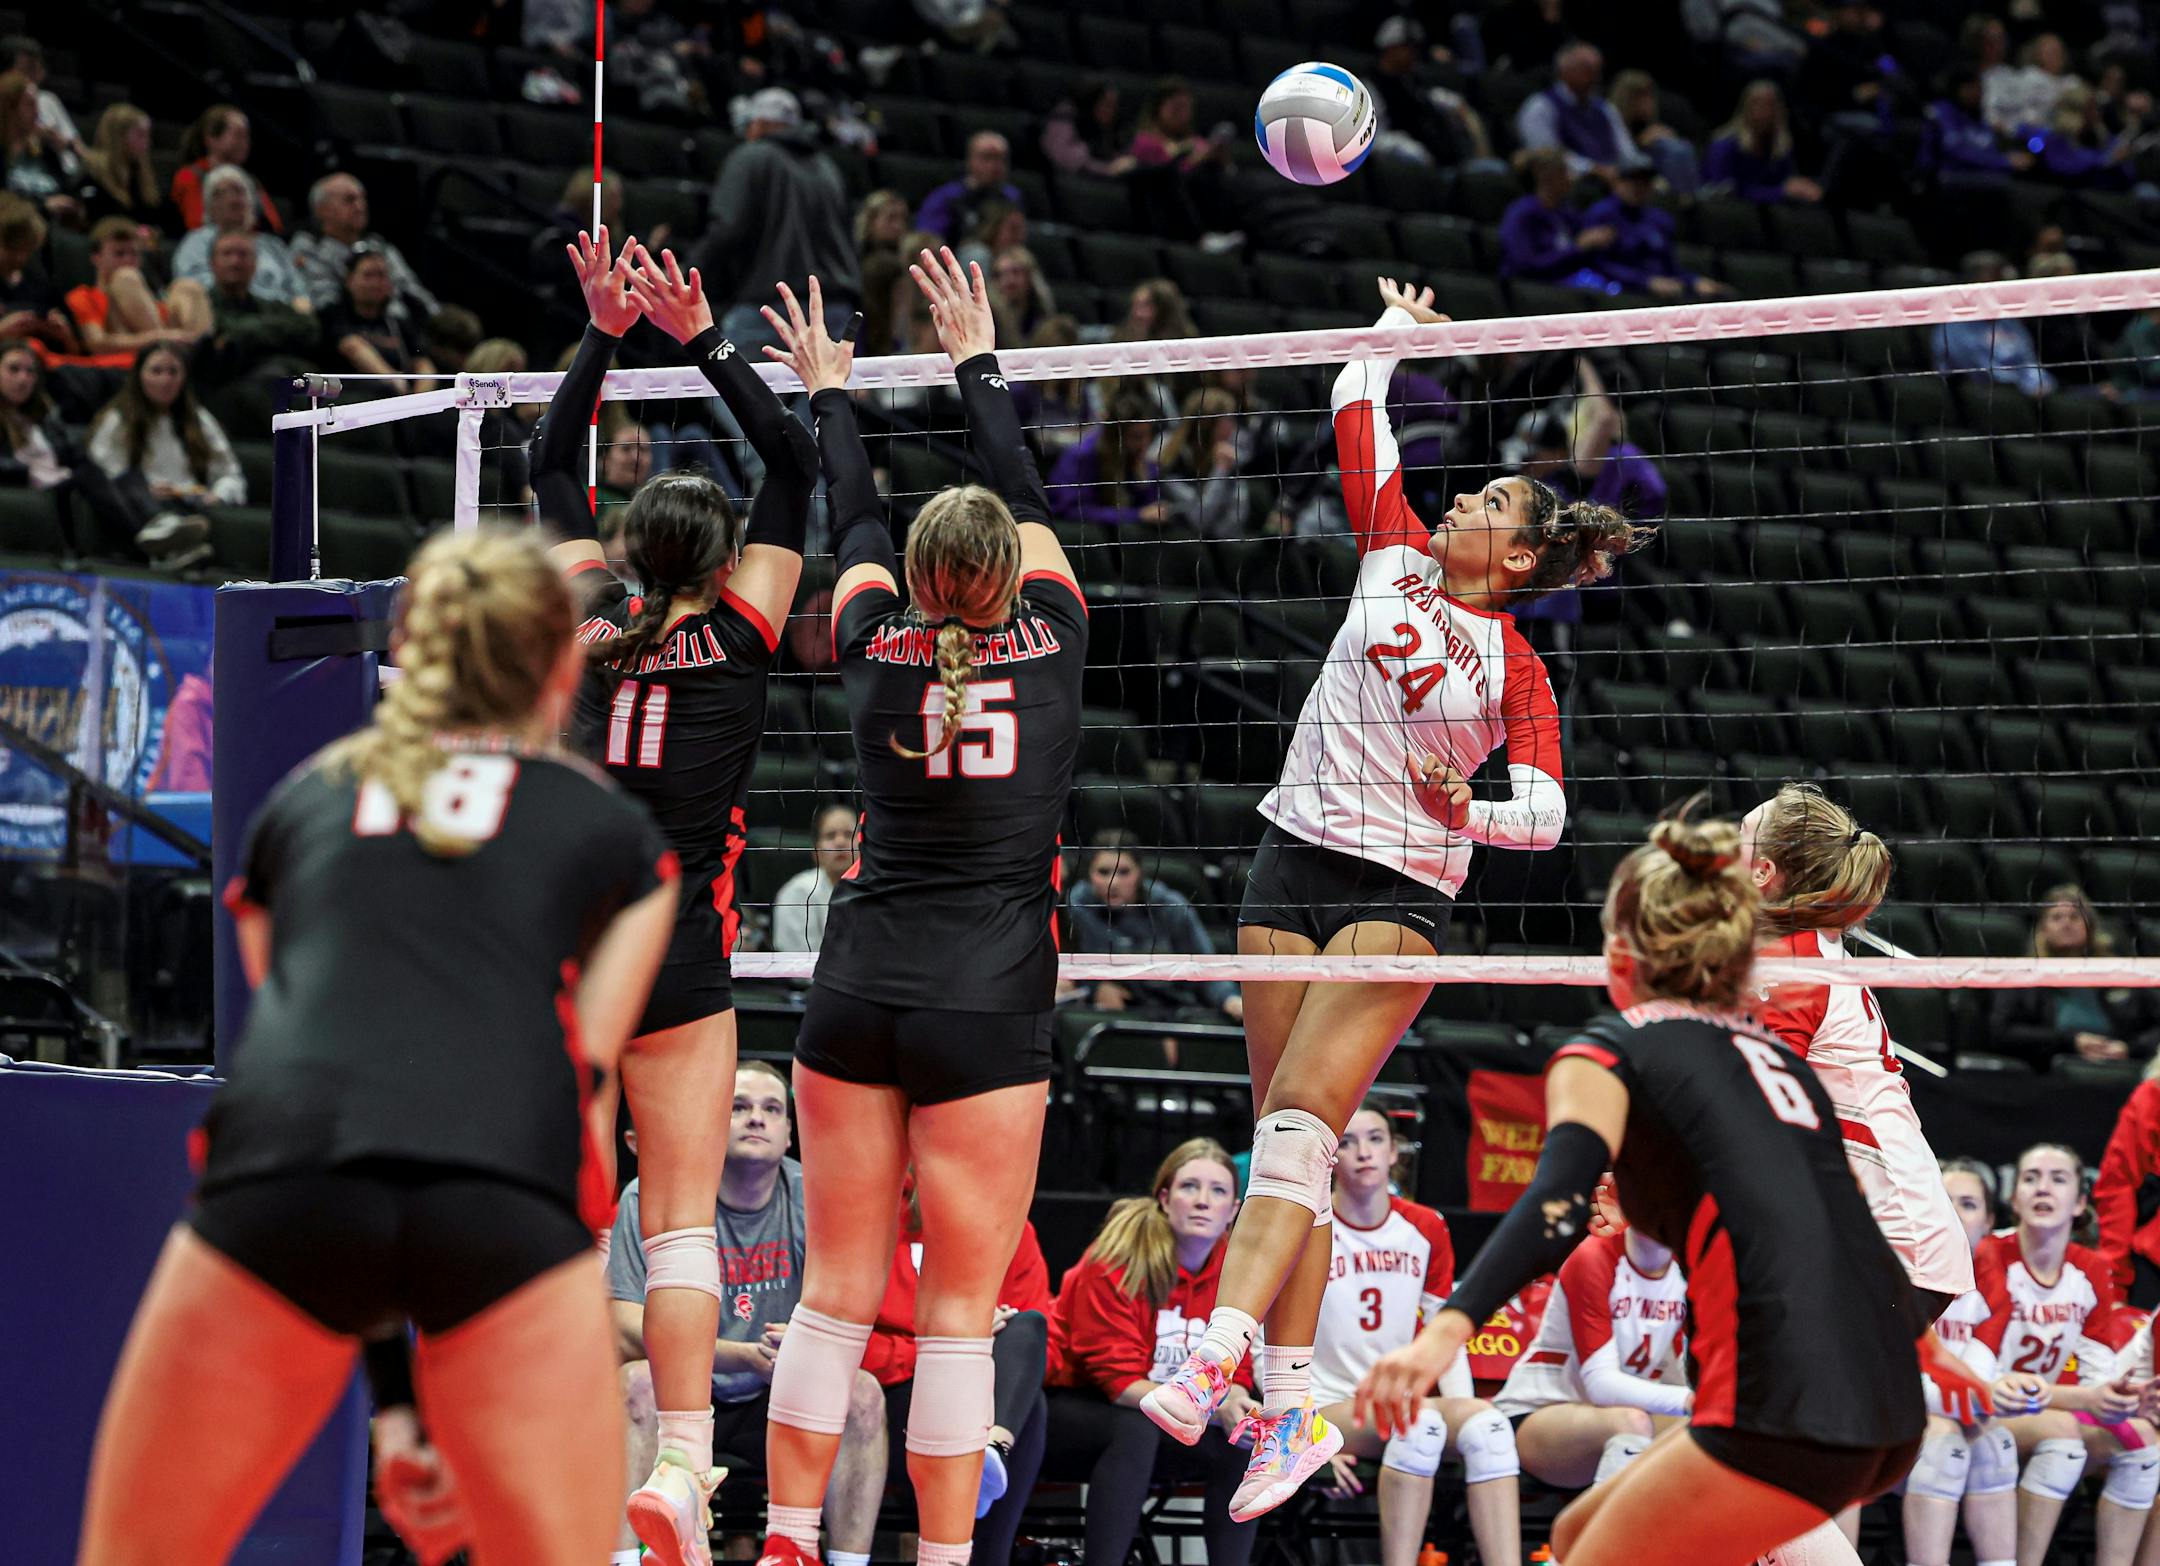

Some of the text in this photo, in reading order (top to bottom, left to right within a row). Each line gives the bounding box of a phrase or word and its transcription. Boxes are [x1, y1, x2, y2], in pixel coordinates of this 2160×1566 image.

[475, 379, 500, 388] Senoh
[1392, 573, 1437, 613] RED
[866, 615, 1061, 667] MONCELLO
[1365, 622, 1447, 716] 24
[606, 678, 670, 769] 11
[918, 677, 1019, 779] 15
[1730, 1032, 1821, 1130] 6
[1480, 1119, 1544, 1152] WEL
[1359, 1288, 1383, 1331] 3
[1626, 1333, 1653, 1375] 4
[2011, 1334, 2064, 1374] 25
